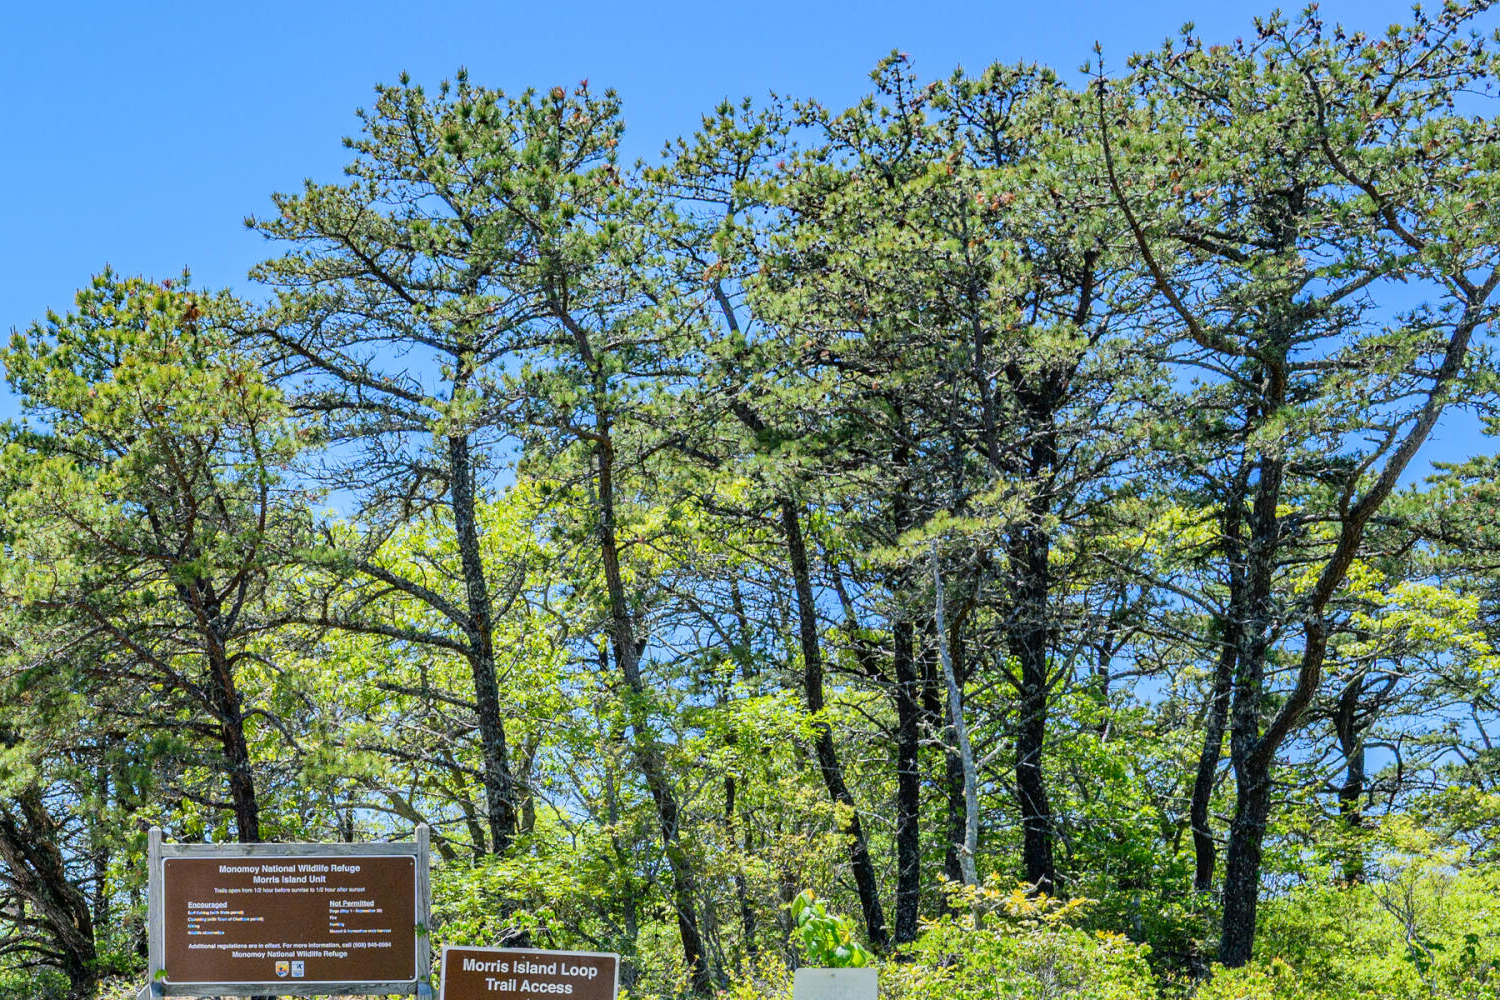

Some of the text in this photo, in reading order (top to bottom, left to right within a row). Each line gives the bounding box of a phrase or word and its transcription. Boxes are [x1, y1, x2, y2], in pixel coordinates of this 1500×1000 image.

[219, 864, 361, 874] Monomoy National Wildlife Refuge
[253, 875, 327, 884] Morris Island Unit
[188, 901, 228, 909] Encouraged
[232, 950, 348, 959] Monomoy National Wildlife Refuge
[463, 958, 598, 980] Morris Island Loop
[485, 978, 573, 994] Trail Access
